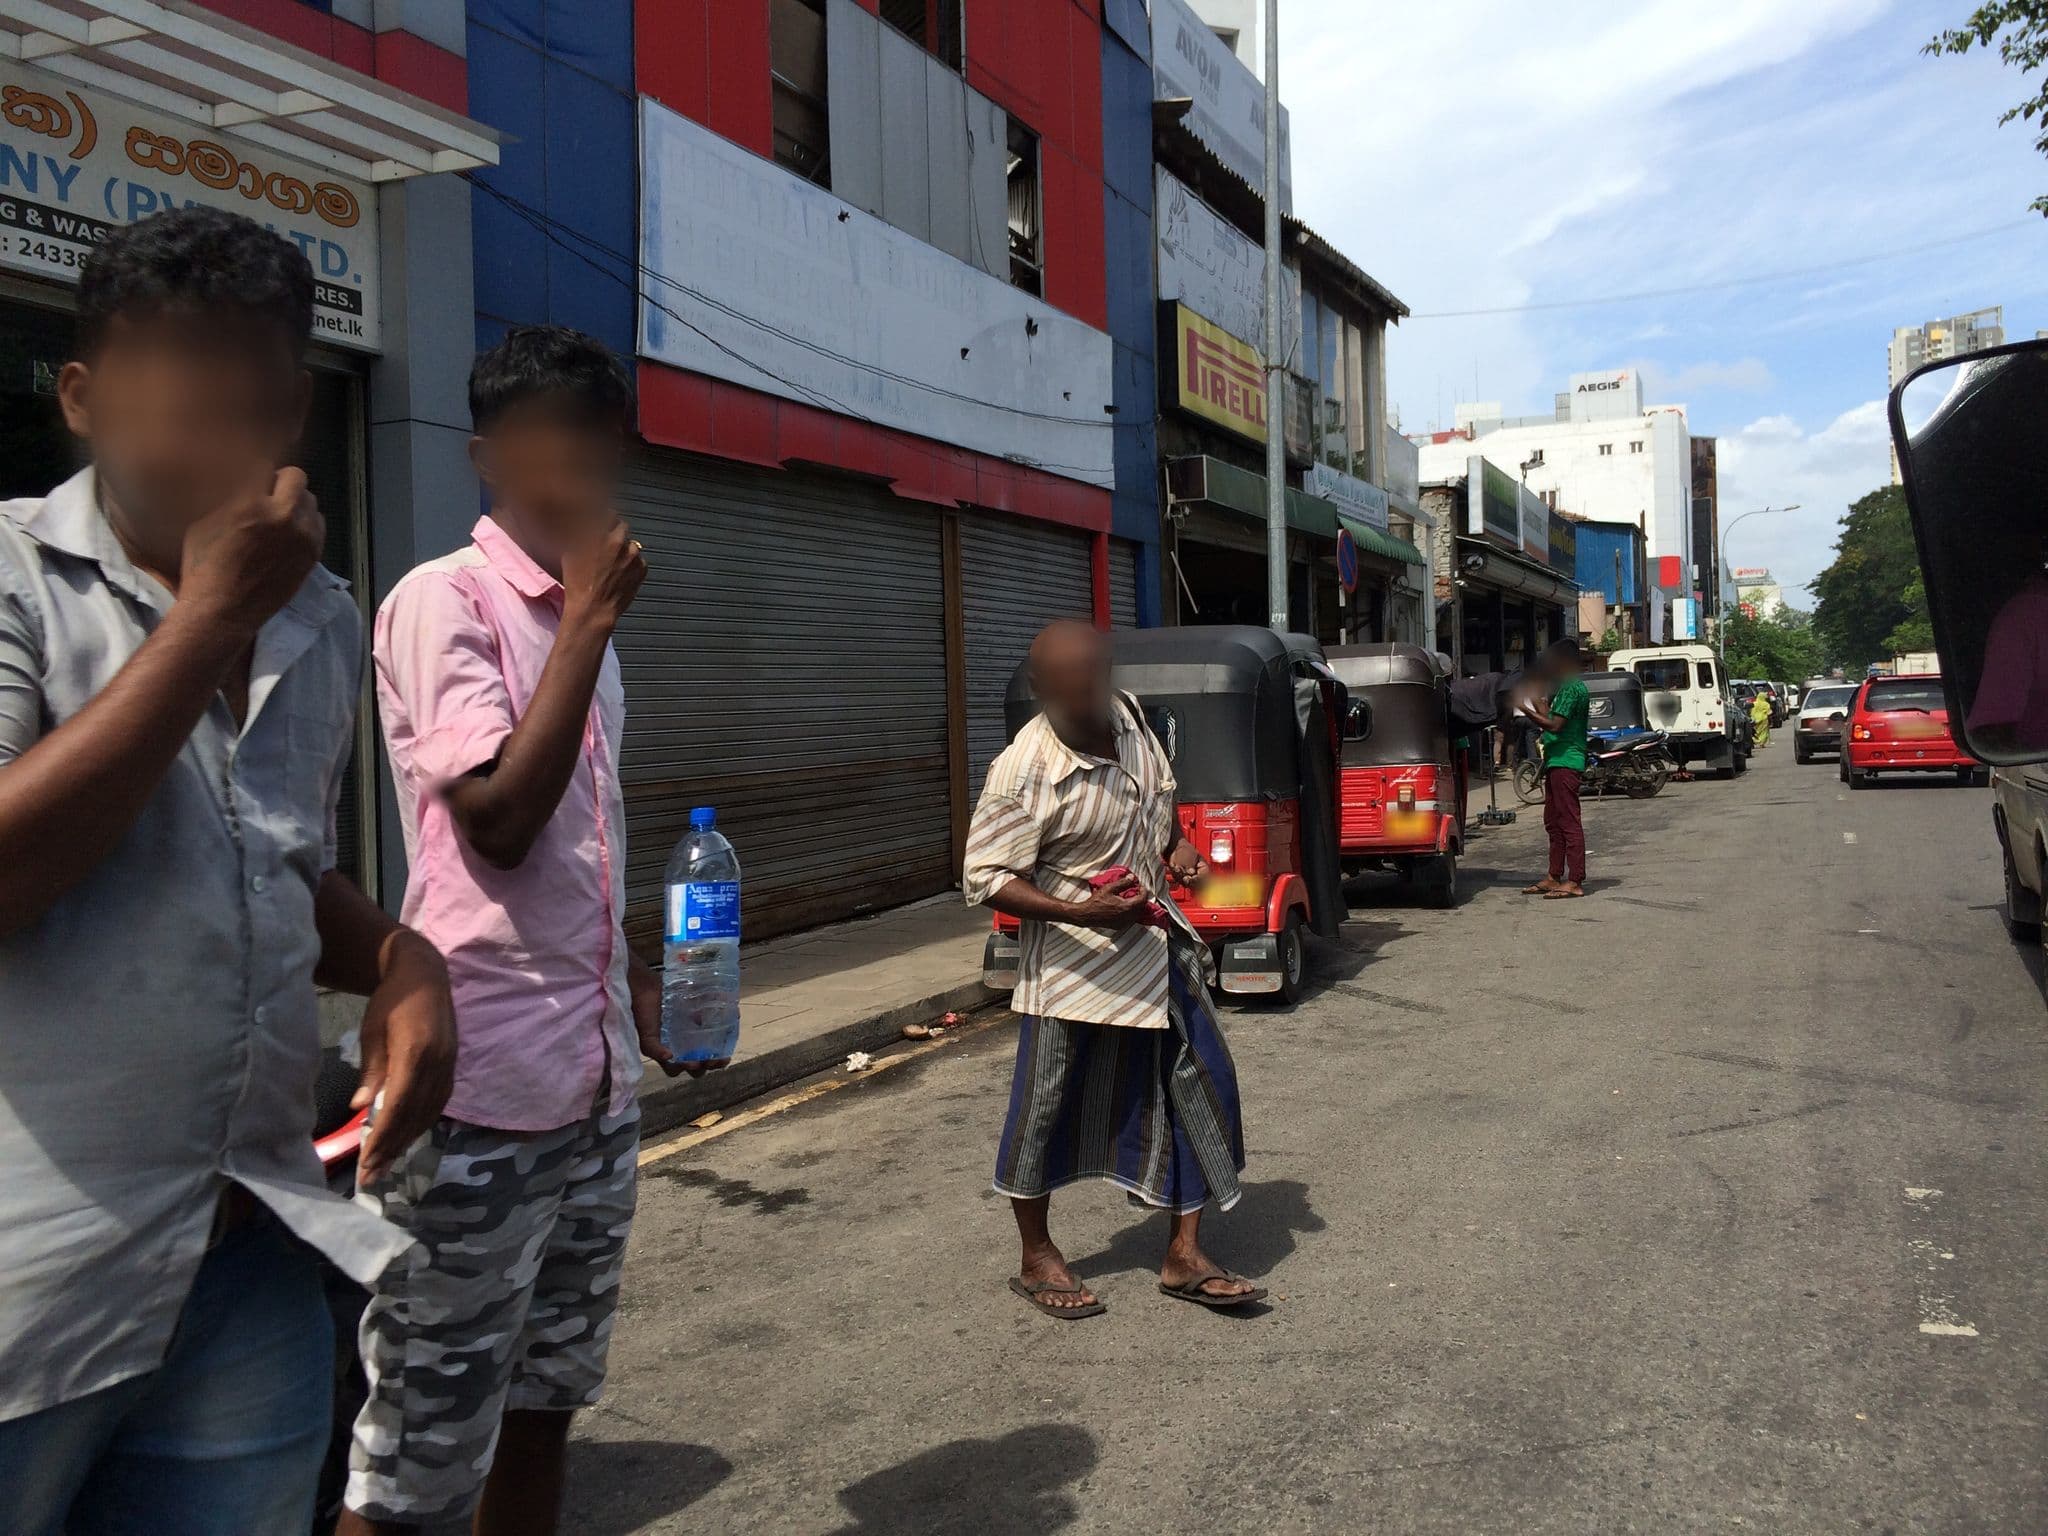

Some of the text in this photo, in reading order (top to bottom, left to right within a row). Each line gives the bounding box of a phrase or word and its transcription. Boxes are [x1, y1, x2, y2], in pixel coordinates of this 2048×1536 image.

[1175, 24, 1221, 93] AVON
[25, 208, 44, 228] &
[52, 214, 112, 243] WAS
[266, 223, 362, 284] TD.
[312, 315, 363, 337] net.lk
[1186, 327, 1267, 428] PIRELL
[1577, 381, 1621, 393] AEGIS
